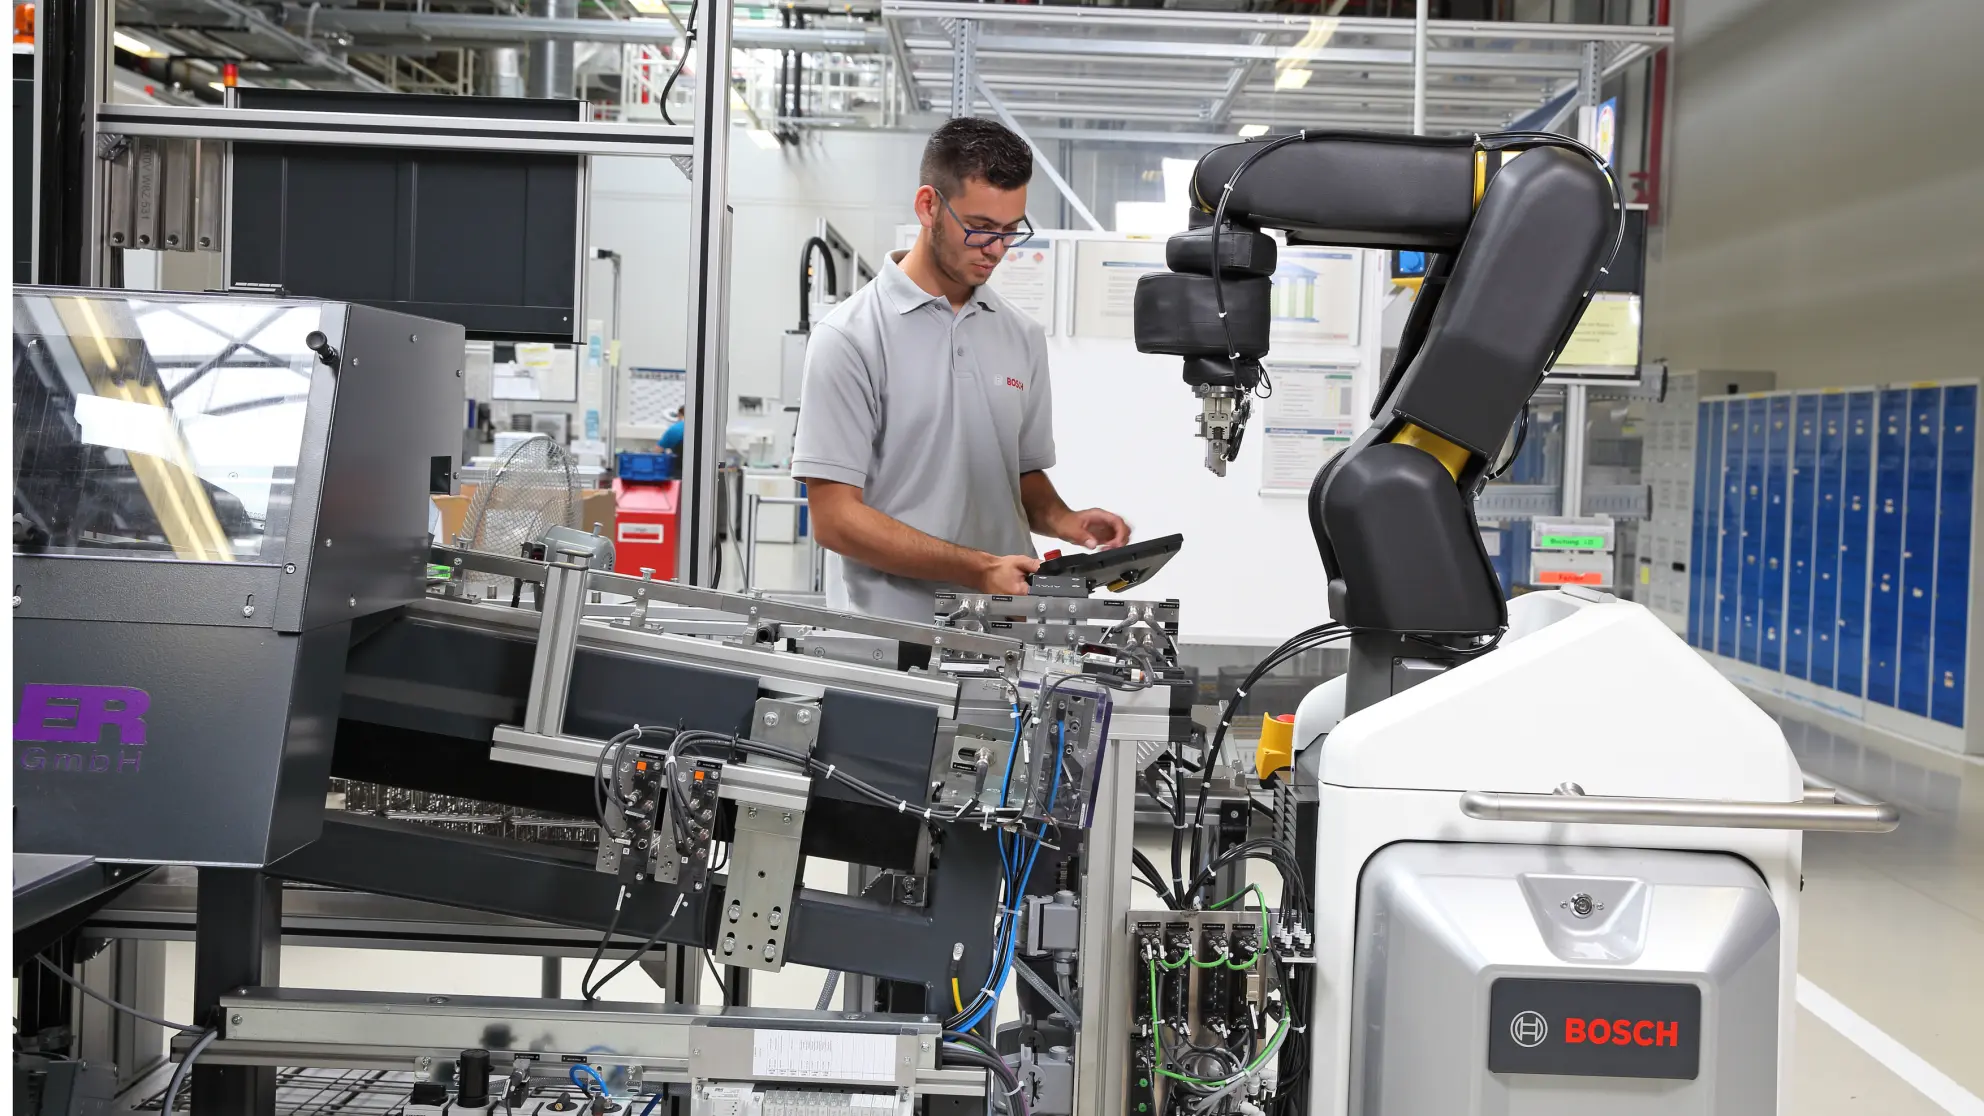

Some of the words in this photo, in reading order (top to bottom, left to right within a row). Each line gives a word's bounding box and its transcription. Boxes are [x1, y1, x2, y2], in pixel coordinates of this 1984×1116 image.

[13, 683, 150, 745] ER
[20, 747, 143, 772] GmbH
[1565, 1017, 1679, 1047] BOSCH
